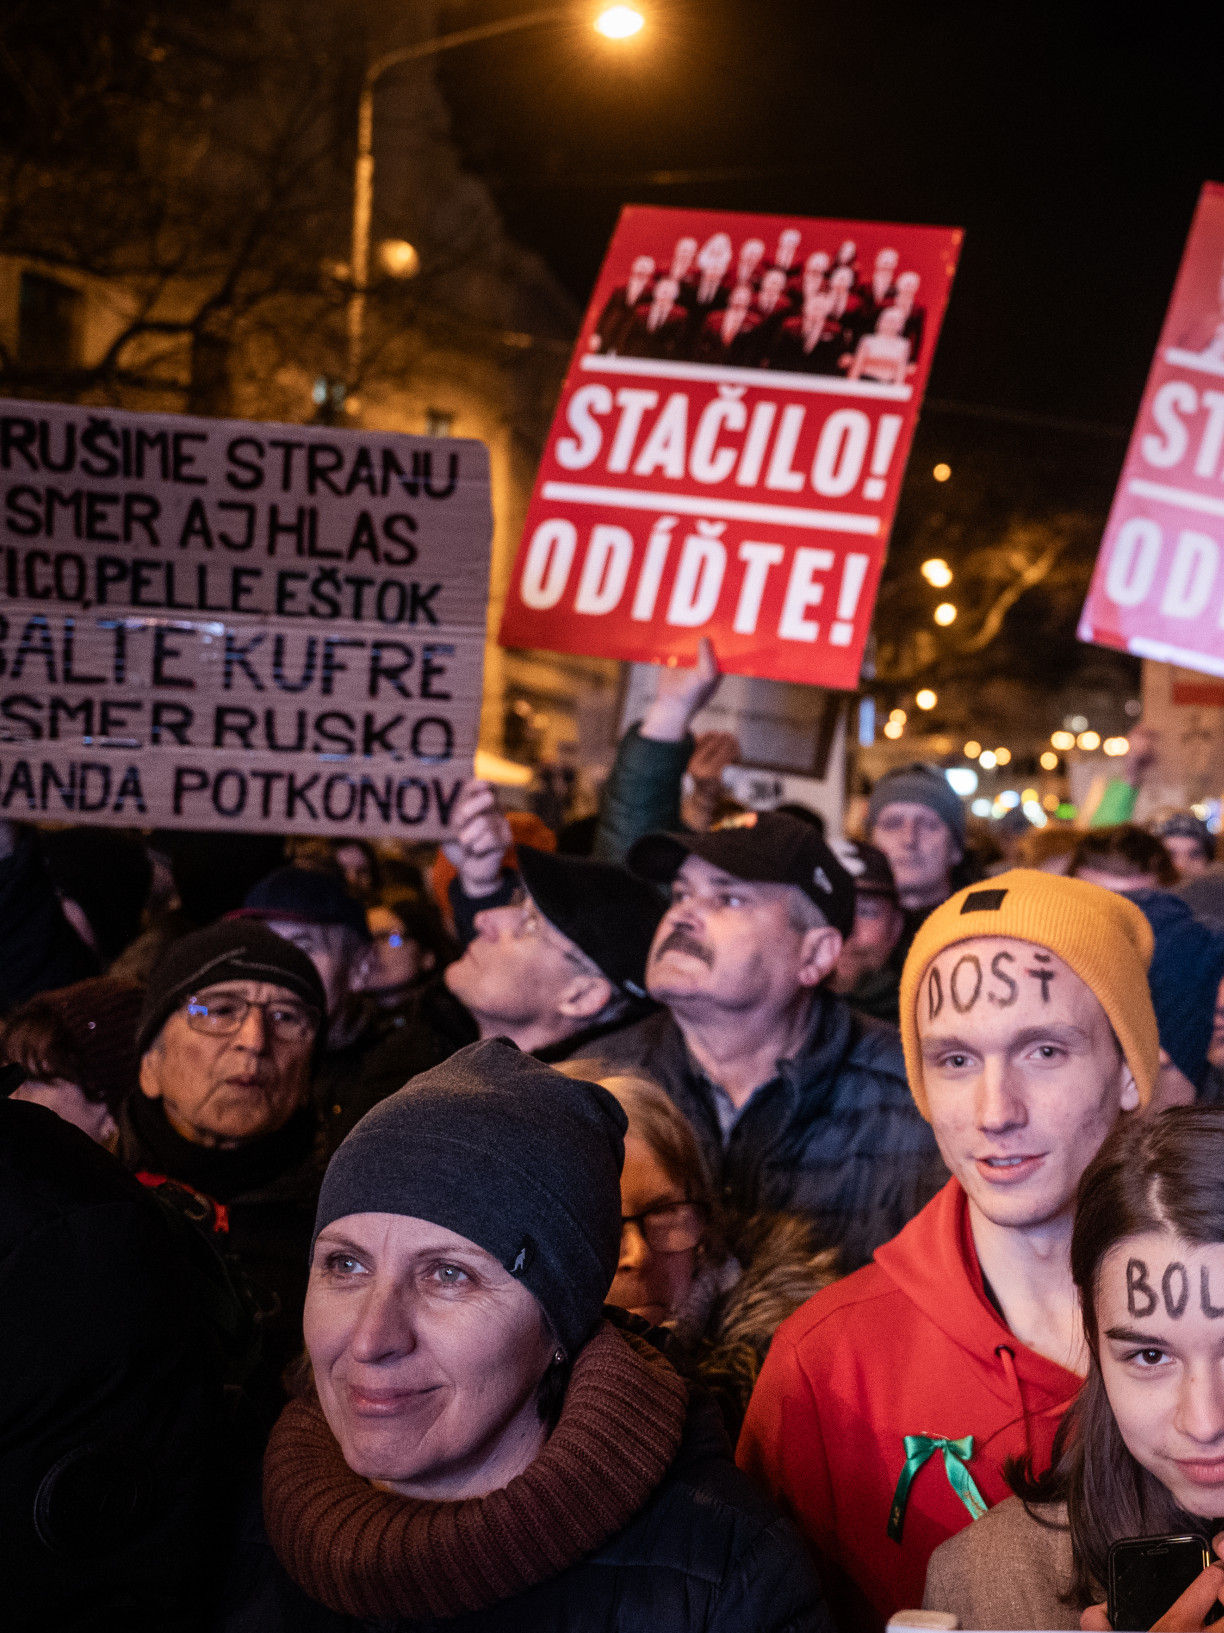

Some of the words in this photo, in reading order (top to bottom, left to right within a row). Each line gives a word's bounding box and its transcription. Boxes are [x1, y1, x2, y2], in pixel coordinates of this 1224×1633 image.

[0, 415, 208, 485] RUŠIME
[225, 436, 460, 499] STRANU
[554, 384, 902, 501] STAČILO!
[5, 485, 162, 547] SMER
[267, 503, 419, 566] HLAS
[276, 566, 442, 626] EŠTOK
[520, 516, 869, 646] ODÍĎTE!
[0, 614, 197, 690] ALTE
[223, 629, 455, 700] KUFRE
[0, 694, 192, 748] SMER
[213, 706, 455, 764] RUSKO
[0, 761, 146, 814] ANDA
[173, 767, 463, 827] POTKONOV
